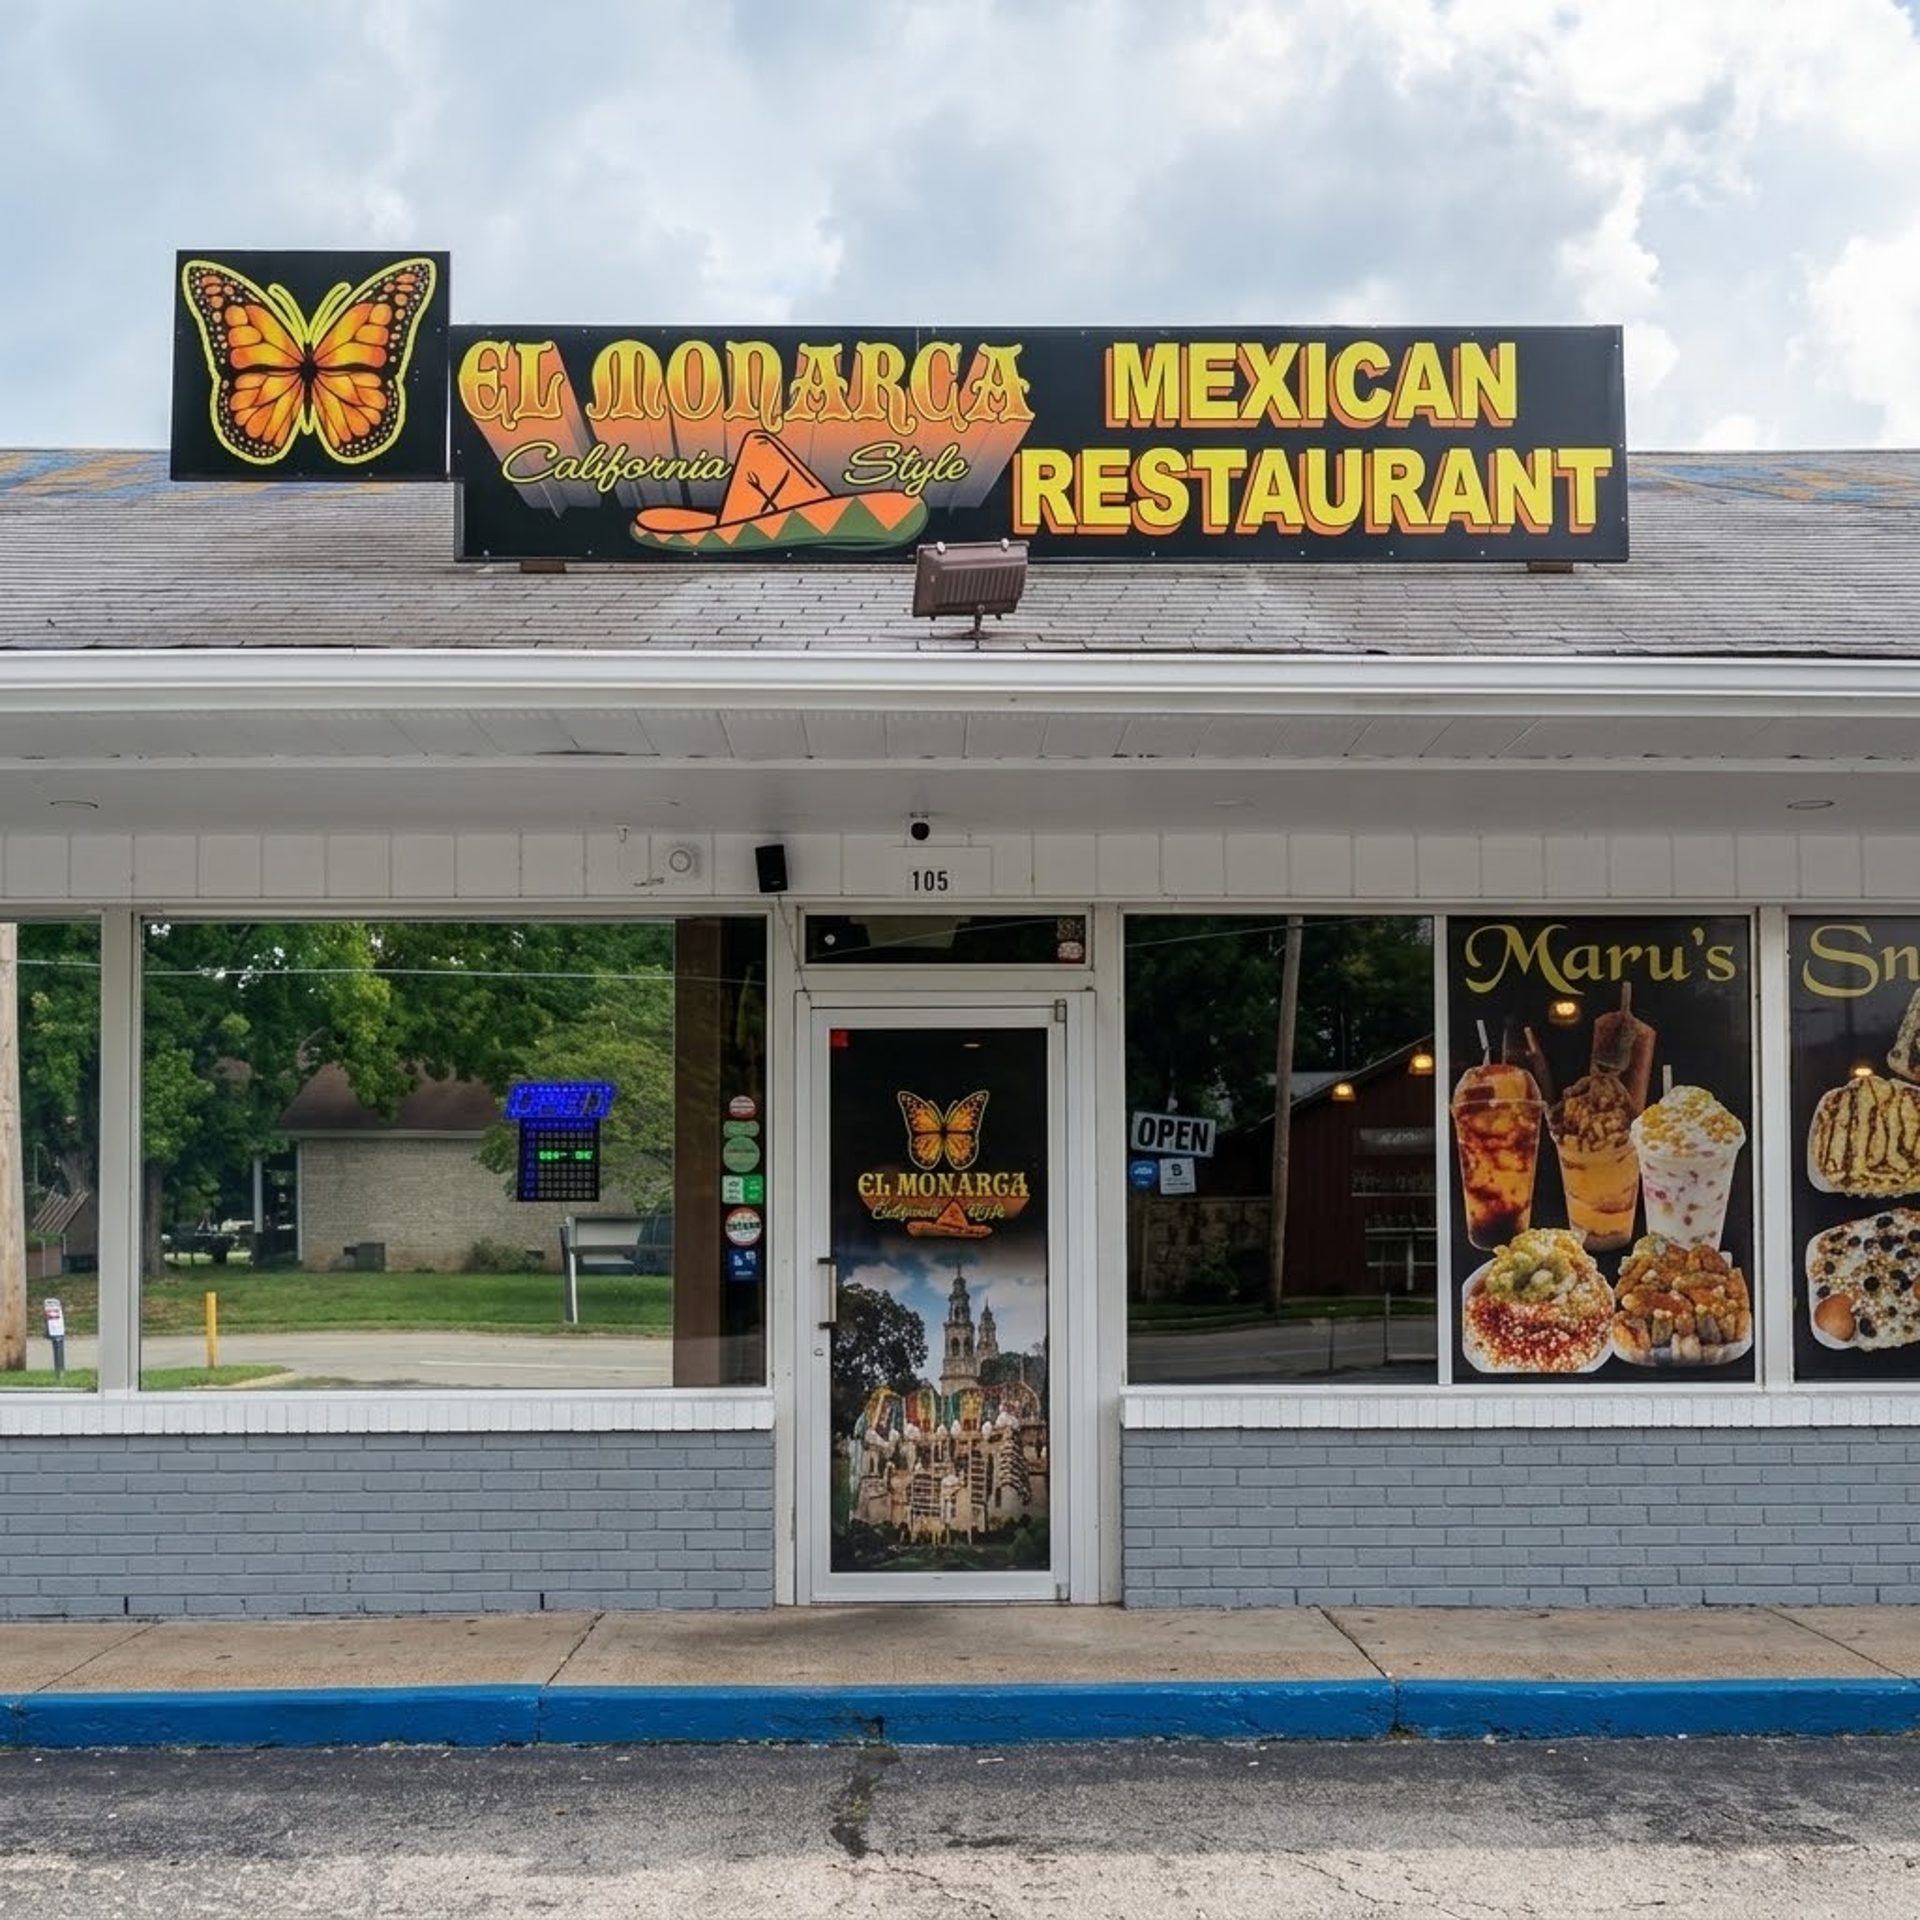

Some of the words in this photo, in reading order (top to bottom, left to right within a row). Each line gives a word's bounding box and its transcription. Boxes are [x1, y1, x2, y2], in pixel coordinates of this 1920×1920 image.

[458, 340, 565, 430] EL
[585, 339, 1035, 435] MONARCA
[1105, 341, 1517, 429] MEXICAN
[501, 441, 732, 492] California
[843, 441, 970, 495] Style
[1012, 447, 1613, 535] RESTAURANT
[912, 870, 949, 892] 105
[1465, 923, 1737, 996] Maru's
[1137, 1117, 1209, 1152] OPEN
[857, 1172, 891, 1197] EL
